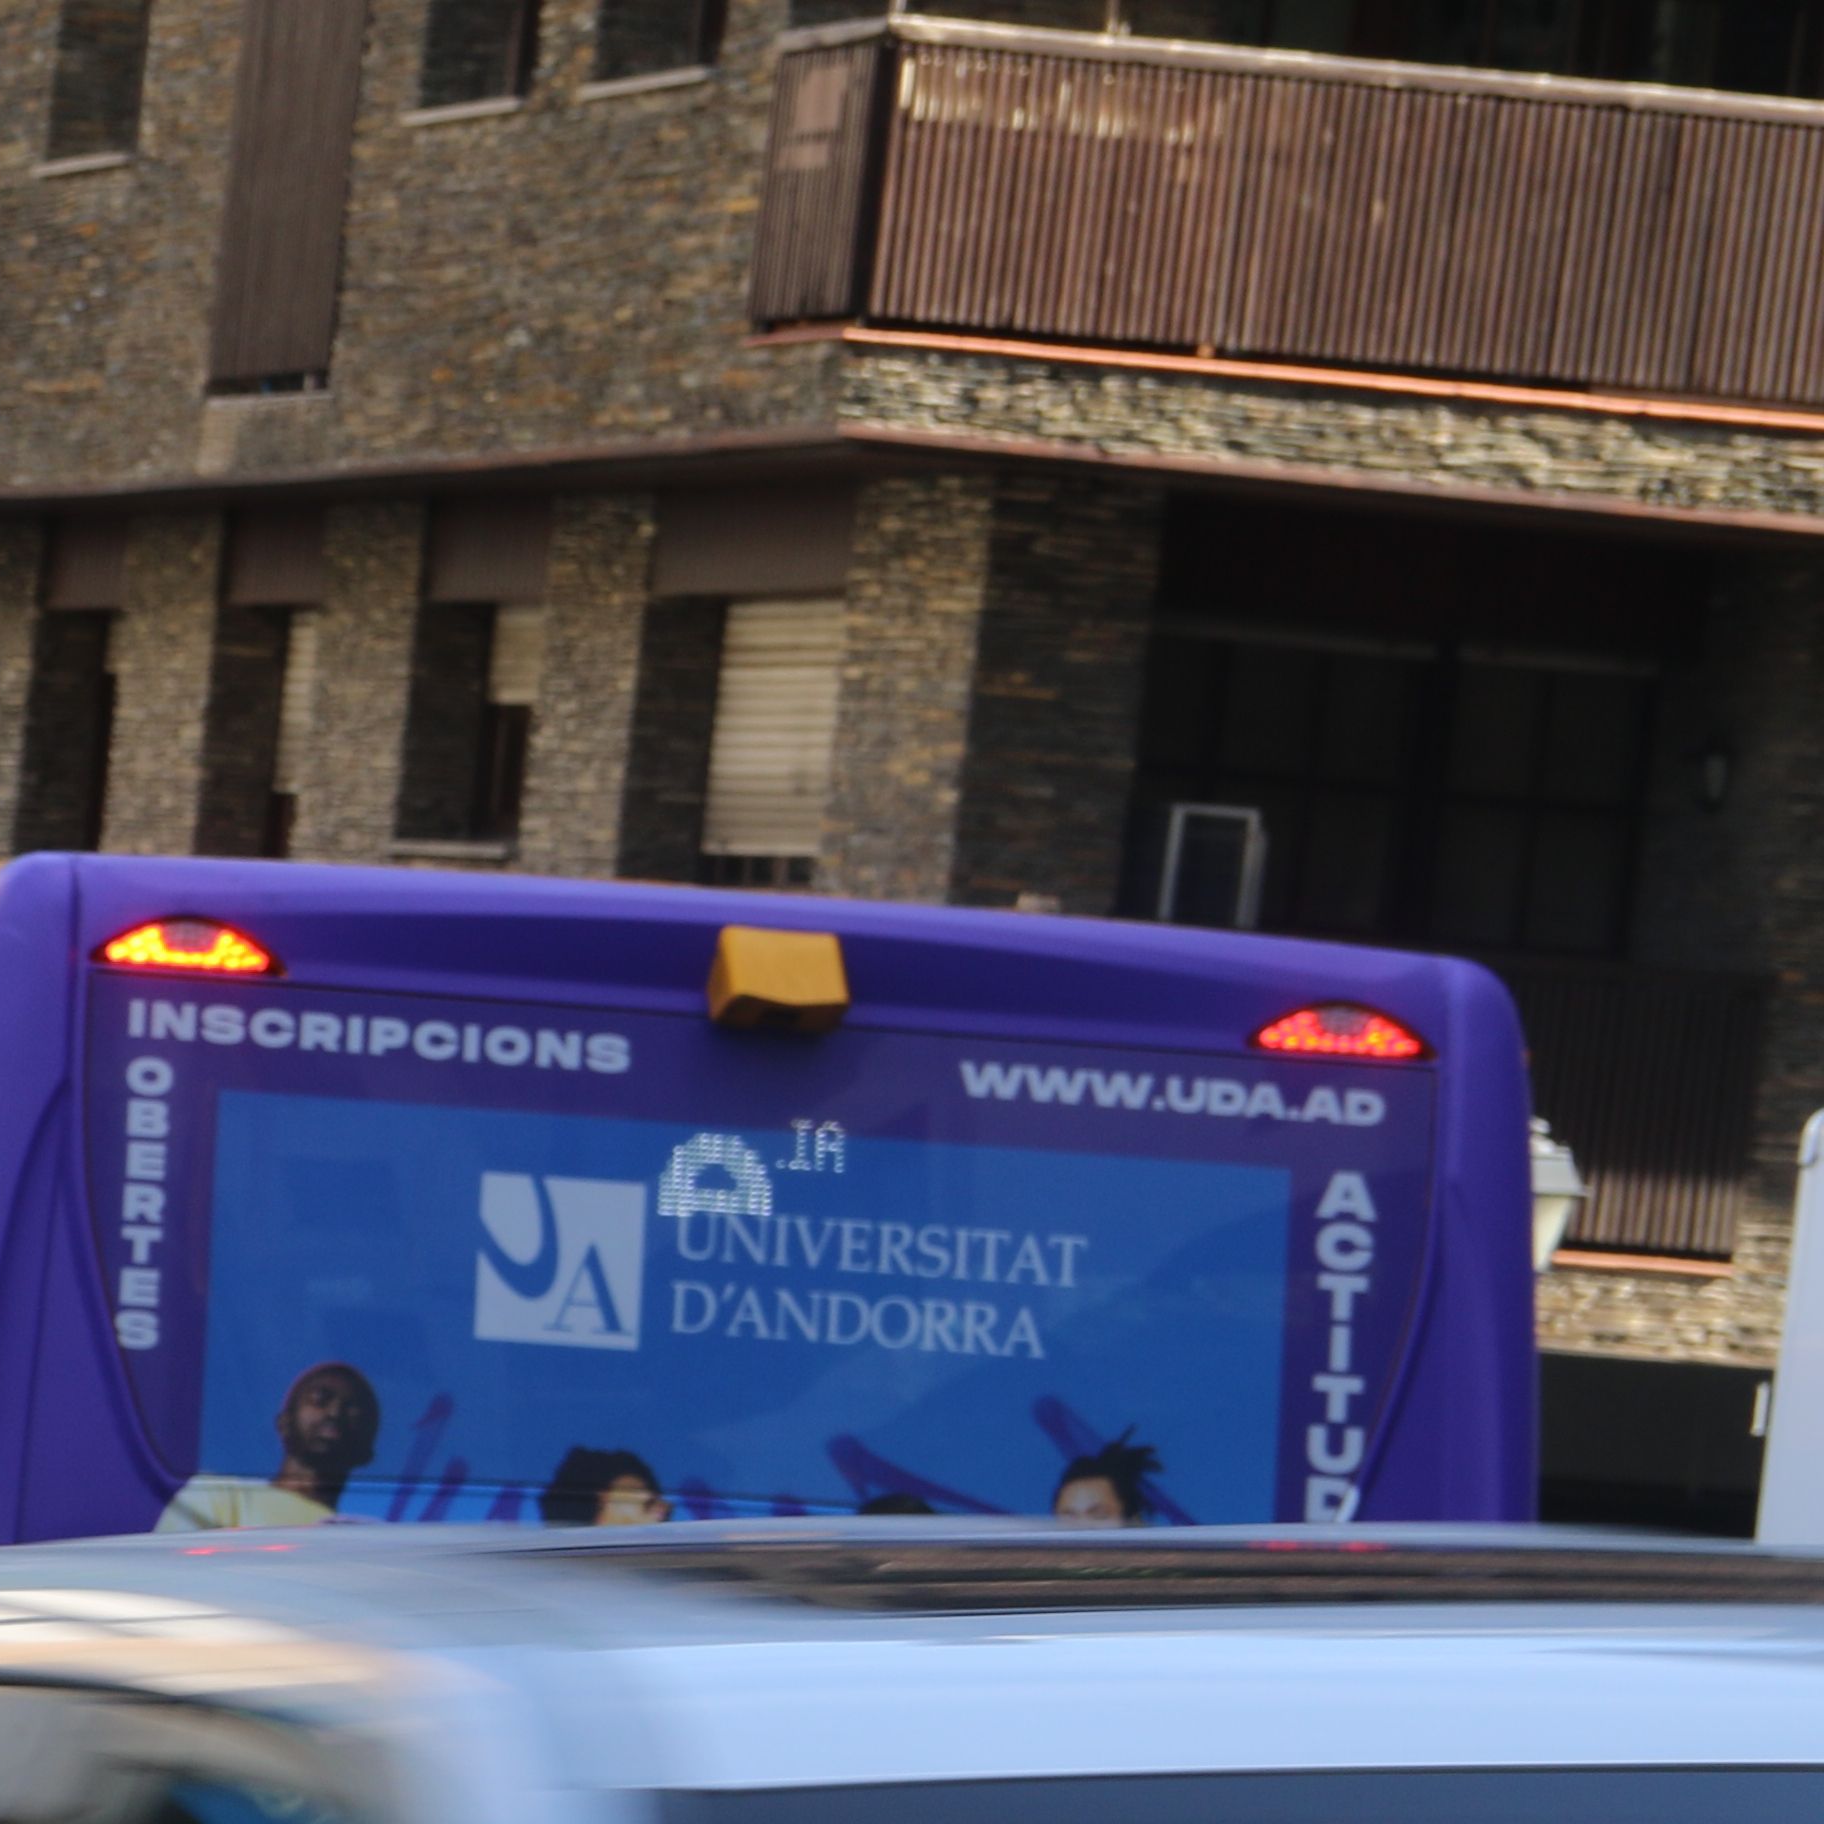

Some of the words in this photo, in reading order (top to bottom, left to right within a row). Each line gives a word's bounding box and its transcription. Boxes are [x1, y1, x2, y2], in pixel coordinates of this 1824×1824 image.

[128, 998, 631, 1074] INSCRIPCIONS
[959, 1059, 1386, 1127] WWW.UDA.AD
[114, 1055, 173, 1350] OBERTES
[676, 1213, 1087, 1288] UNIVERSITAT
[670, 1280, 1046, 1360] D'ANDORRA
[1305, 1171, 1378, 1524] ACTITUD
